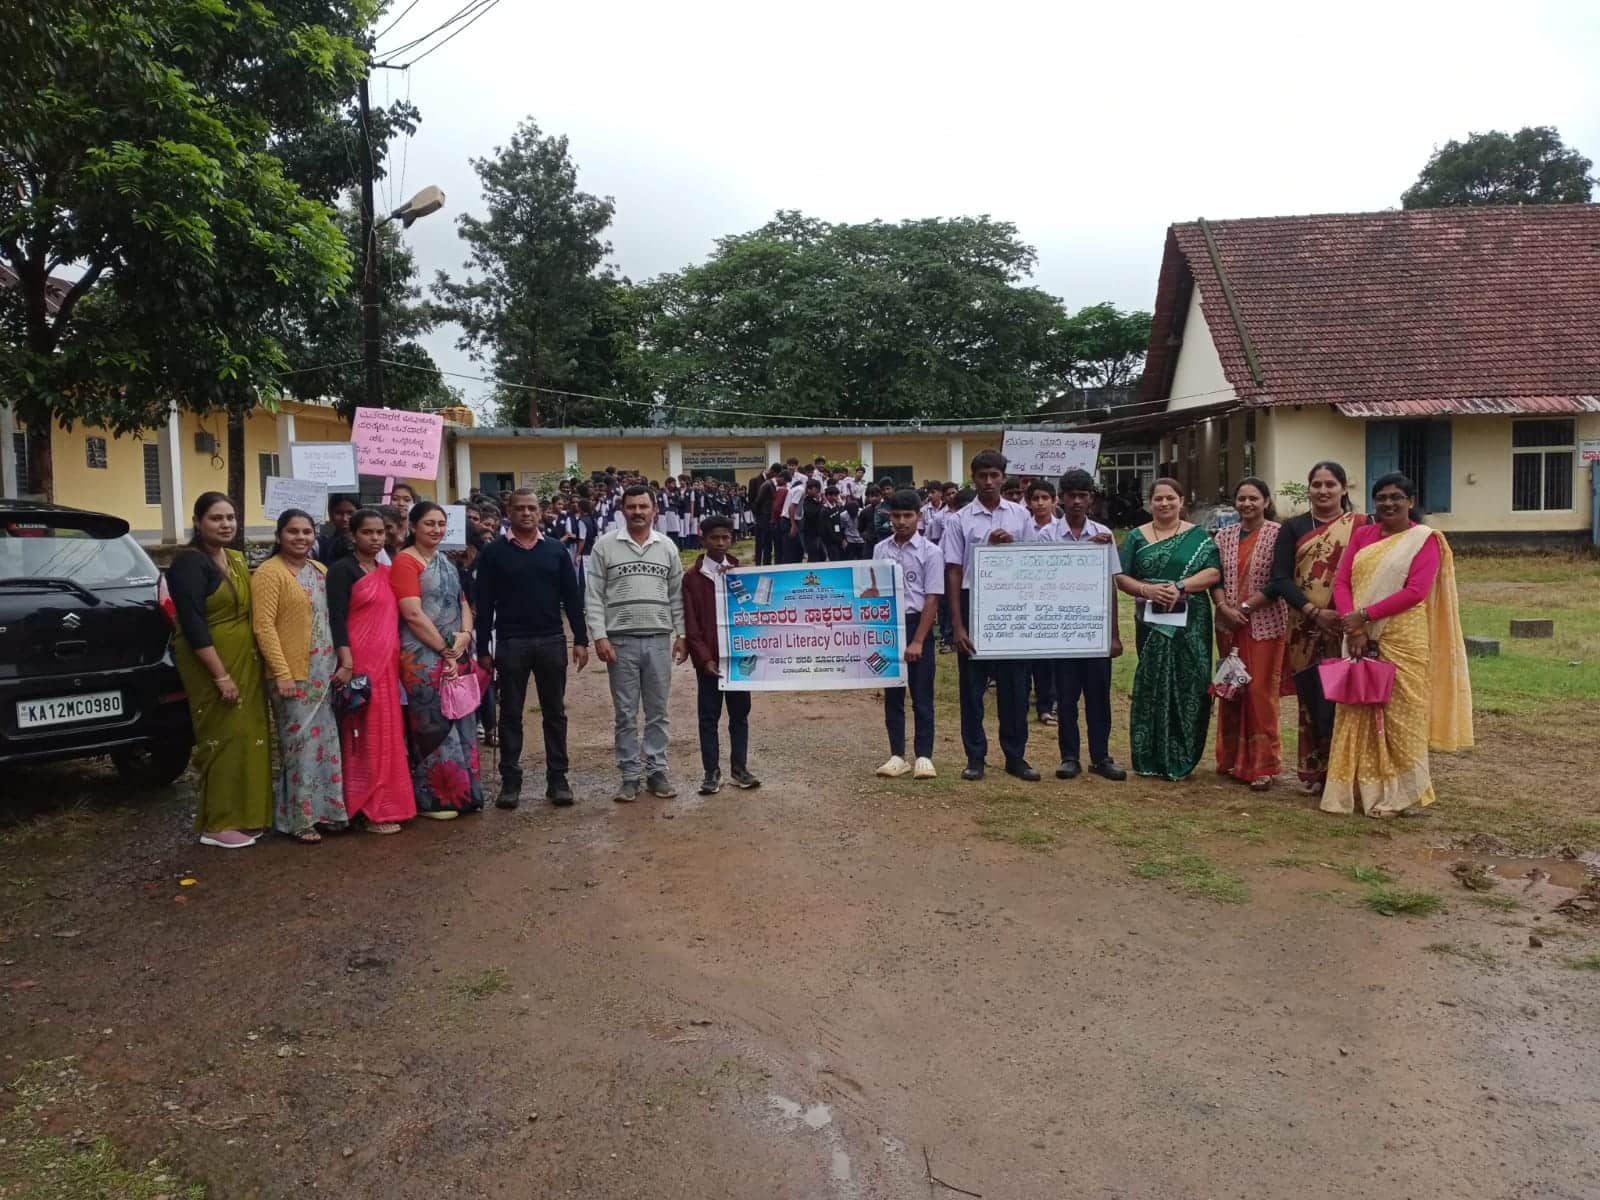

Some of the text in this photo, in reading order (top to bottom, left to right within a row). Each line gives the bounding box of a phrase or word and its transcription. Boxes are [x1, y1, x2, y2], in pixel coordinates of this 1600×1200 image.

[734, 606, 798, 626] ಮತದಾರರ
[860, 600, 890, 623] ಸಂಘ
[733, 629, 896, 654] Electoral Literacy Club (ELC)
[28, 697, 120, 721] KA12MC0980
